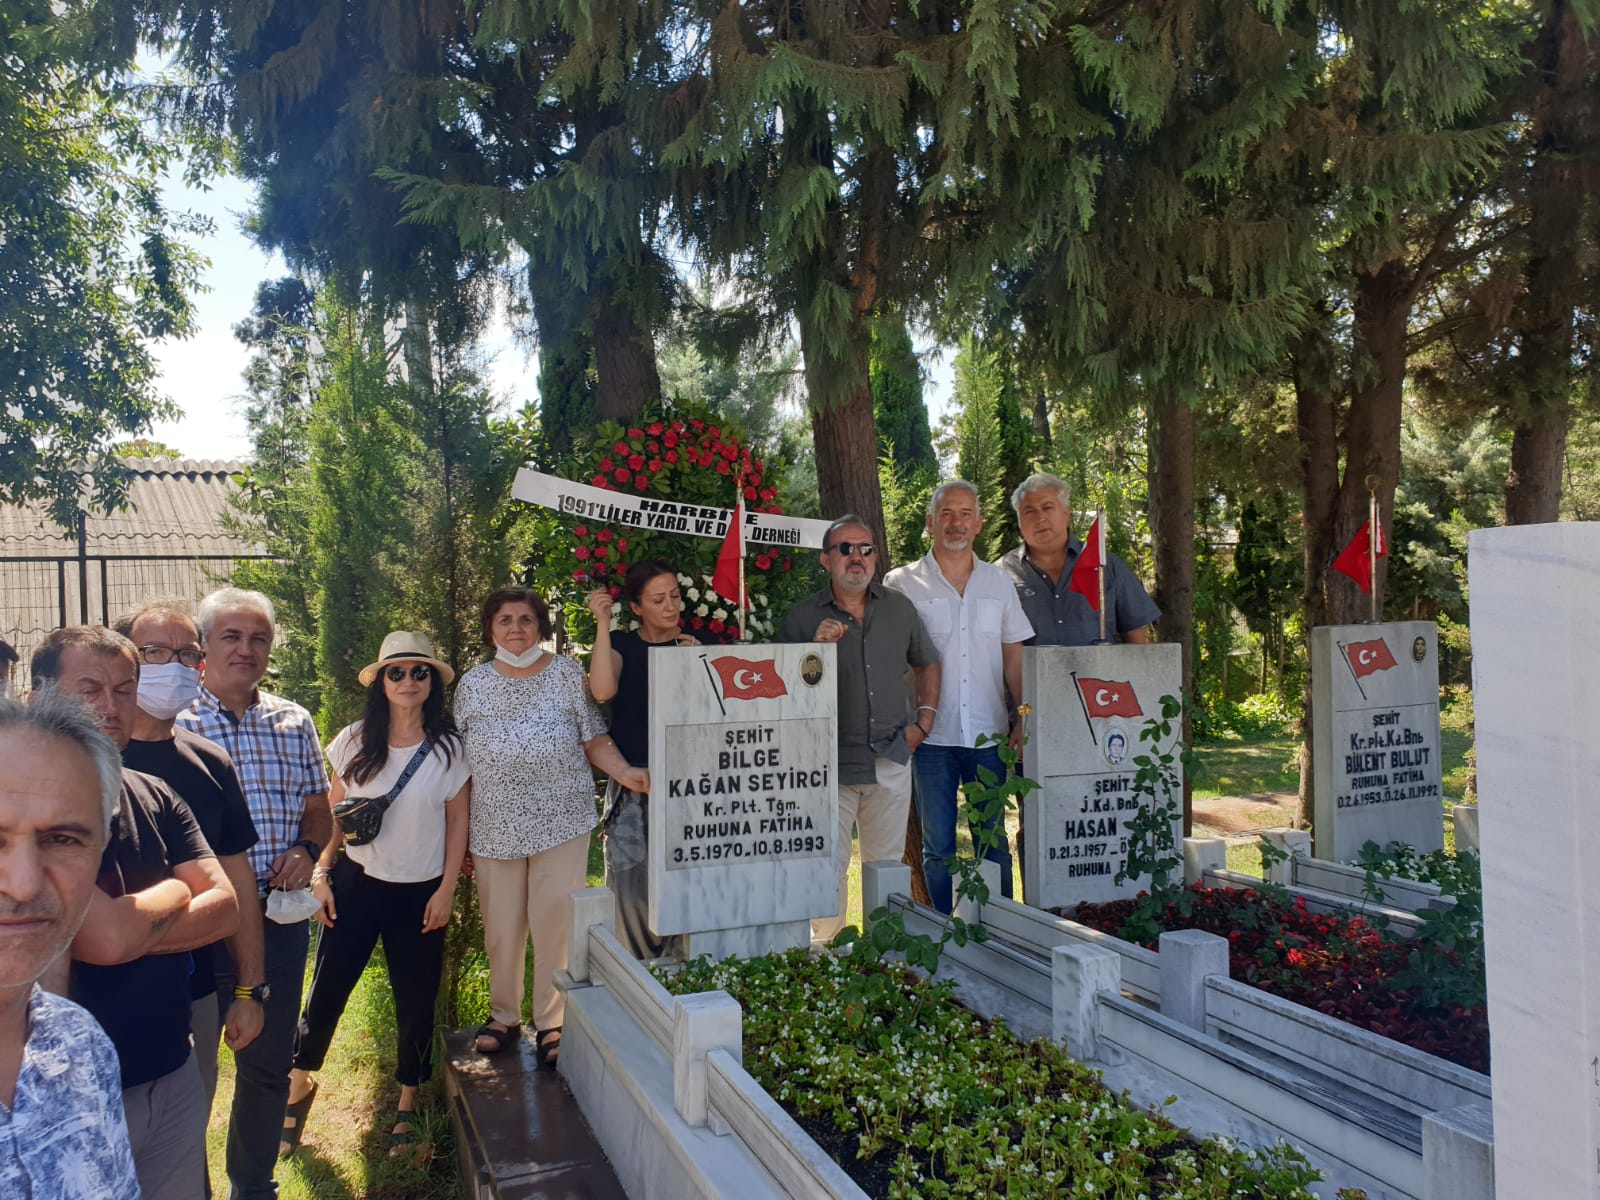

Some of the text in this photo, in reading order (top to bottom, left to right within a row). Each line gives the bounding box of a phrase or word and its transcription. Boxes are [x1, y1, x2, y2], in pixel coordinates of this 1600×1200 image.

[647, 512, 690, 532] YARD.
[694, 519, 713, 535] VE
[752, 526, 800, 545] DERNEĞİ
[1372, 710, 1400, 729] ŞEHİT
[725, 724, 774, 747] ŞEHİT
[718, 746, 780, 770] BİLGE
[1345, 748, 1430, 775] BÜLENT BULUT
[669, 765, 828, 798] KAĞAN SEYİRCİ
[1095, 774, 1130, 795] ŞEHİT
[1351, 768, 1425, 790] RUHUNA FATİHA
[703, 798, 800, 817] Kr. Plt. Tğm.
[684, 813, 814, 840] RUHUNA FATİHA
[1065, 817, 1117, 840] HASAN
[1068, 862, 1112, 878] RUHUNA
